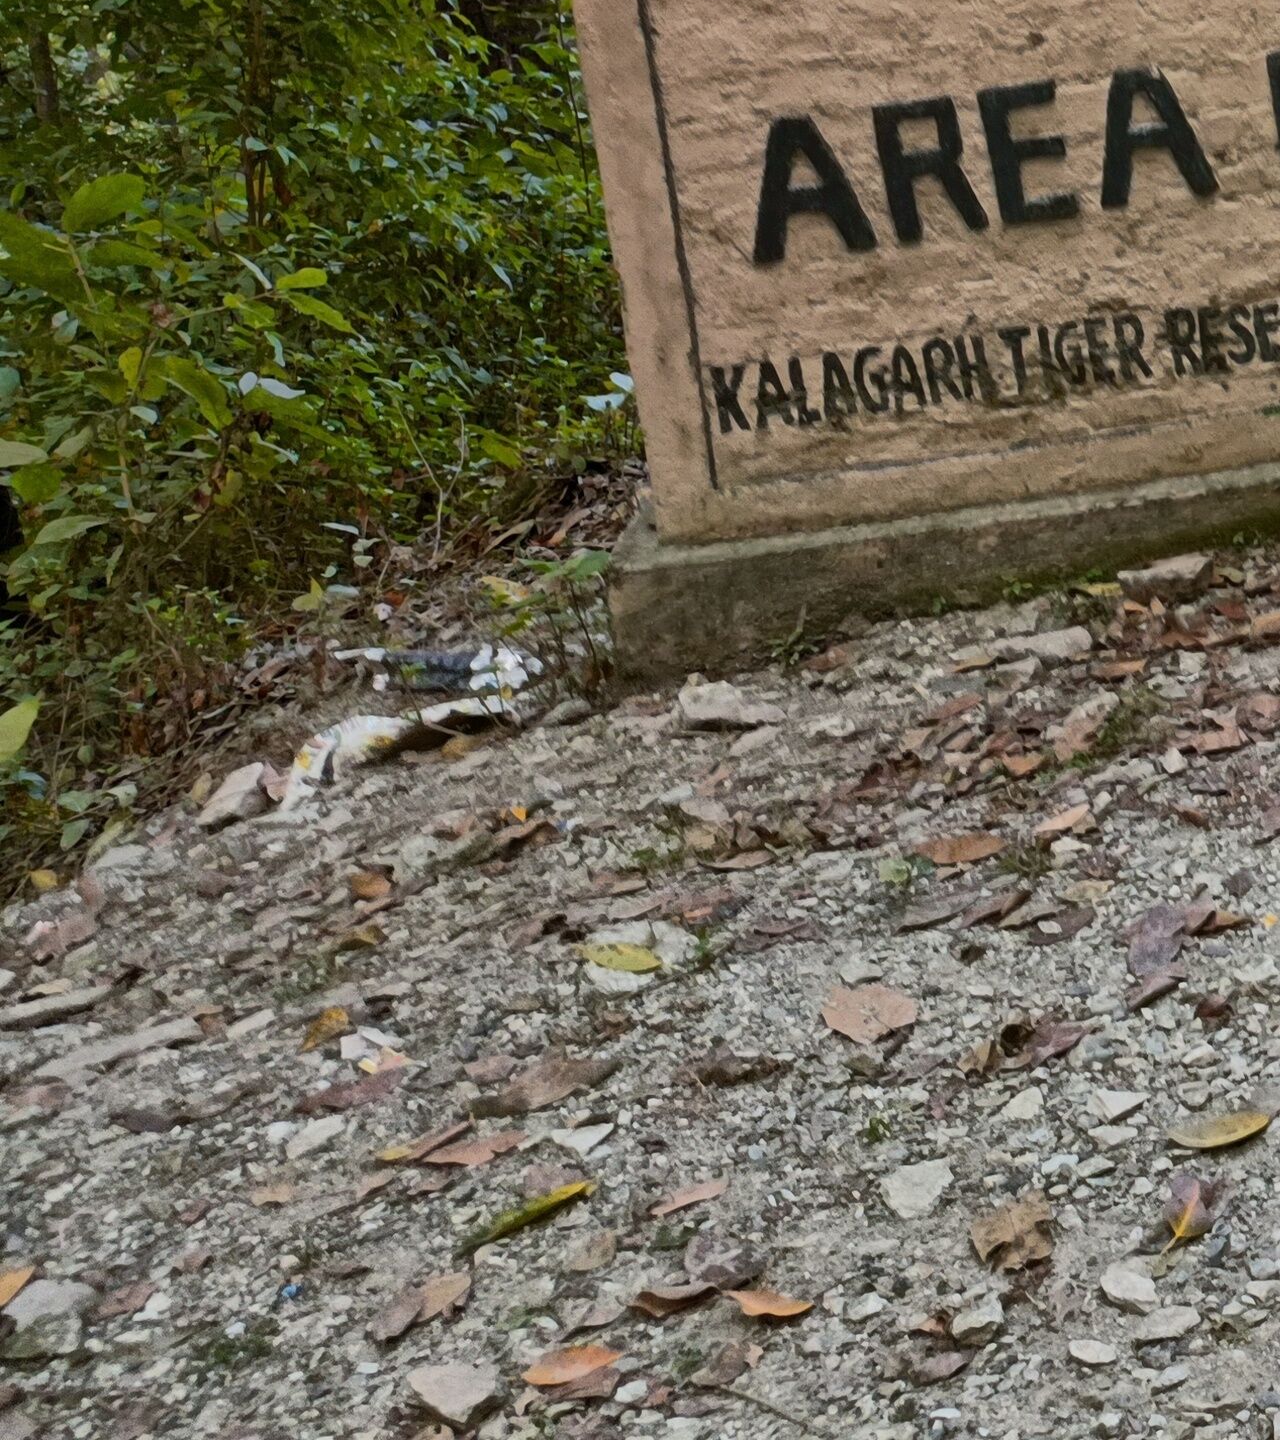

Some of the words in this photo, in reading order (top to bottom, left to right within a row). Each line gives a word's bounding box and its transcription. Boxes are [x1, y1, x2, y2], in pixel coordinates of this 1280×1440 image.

[751, 66, 1218, 264] AREA
[708, 335, 996, 433] KALAGARH
[999, 310, 1152, 397] TIGER
